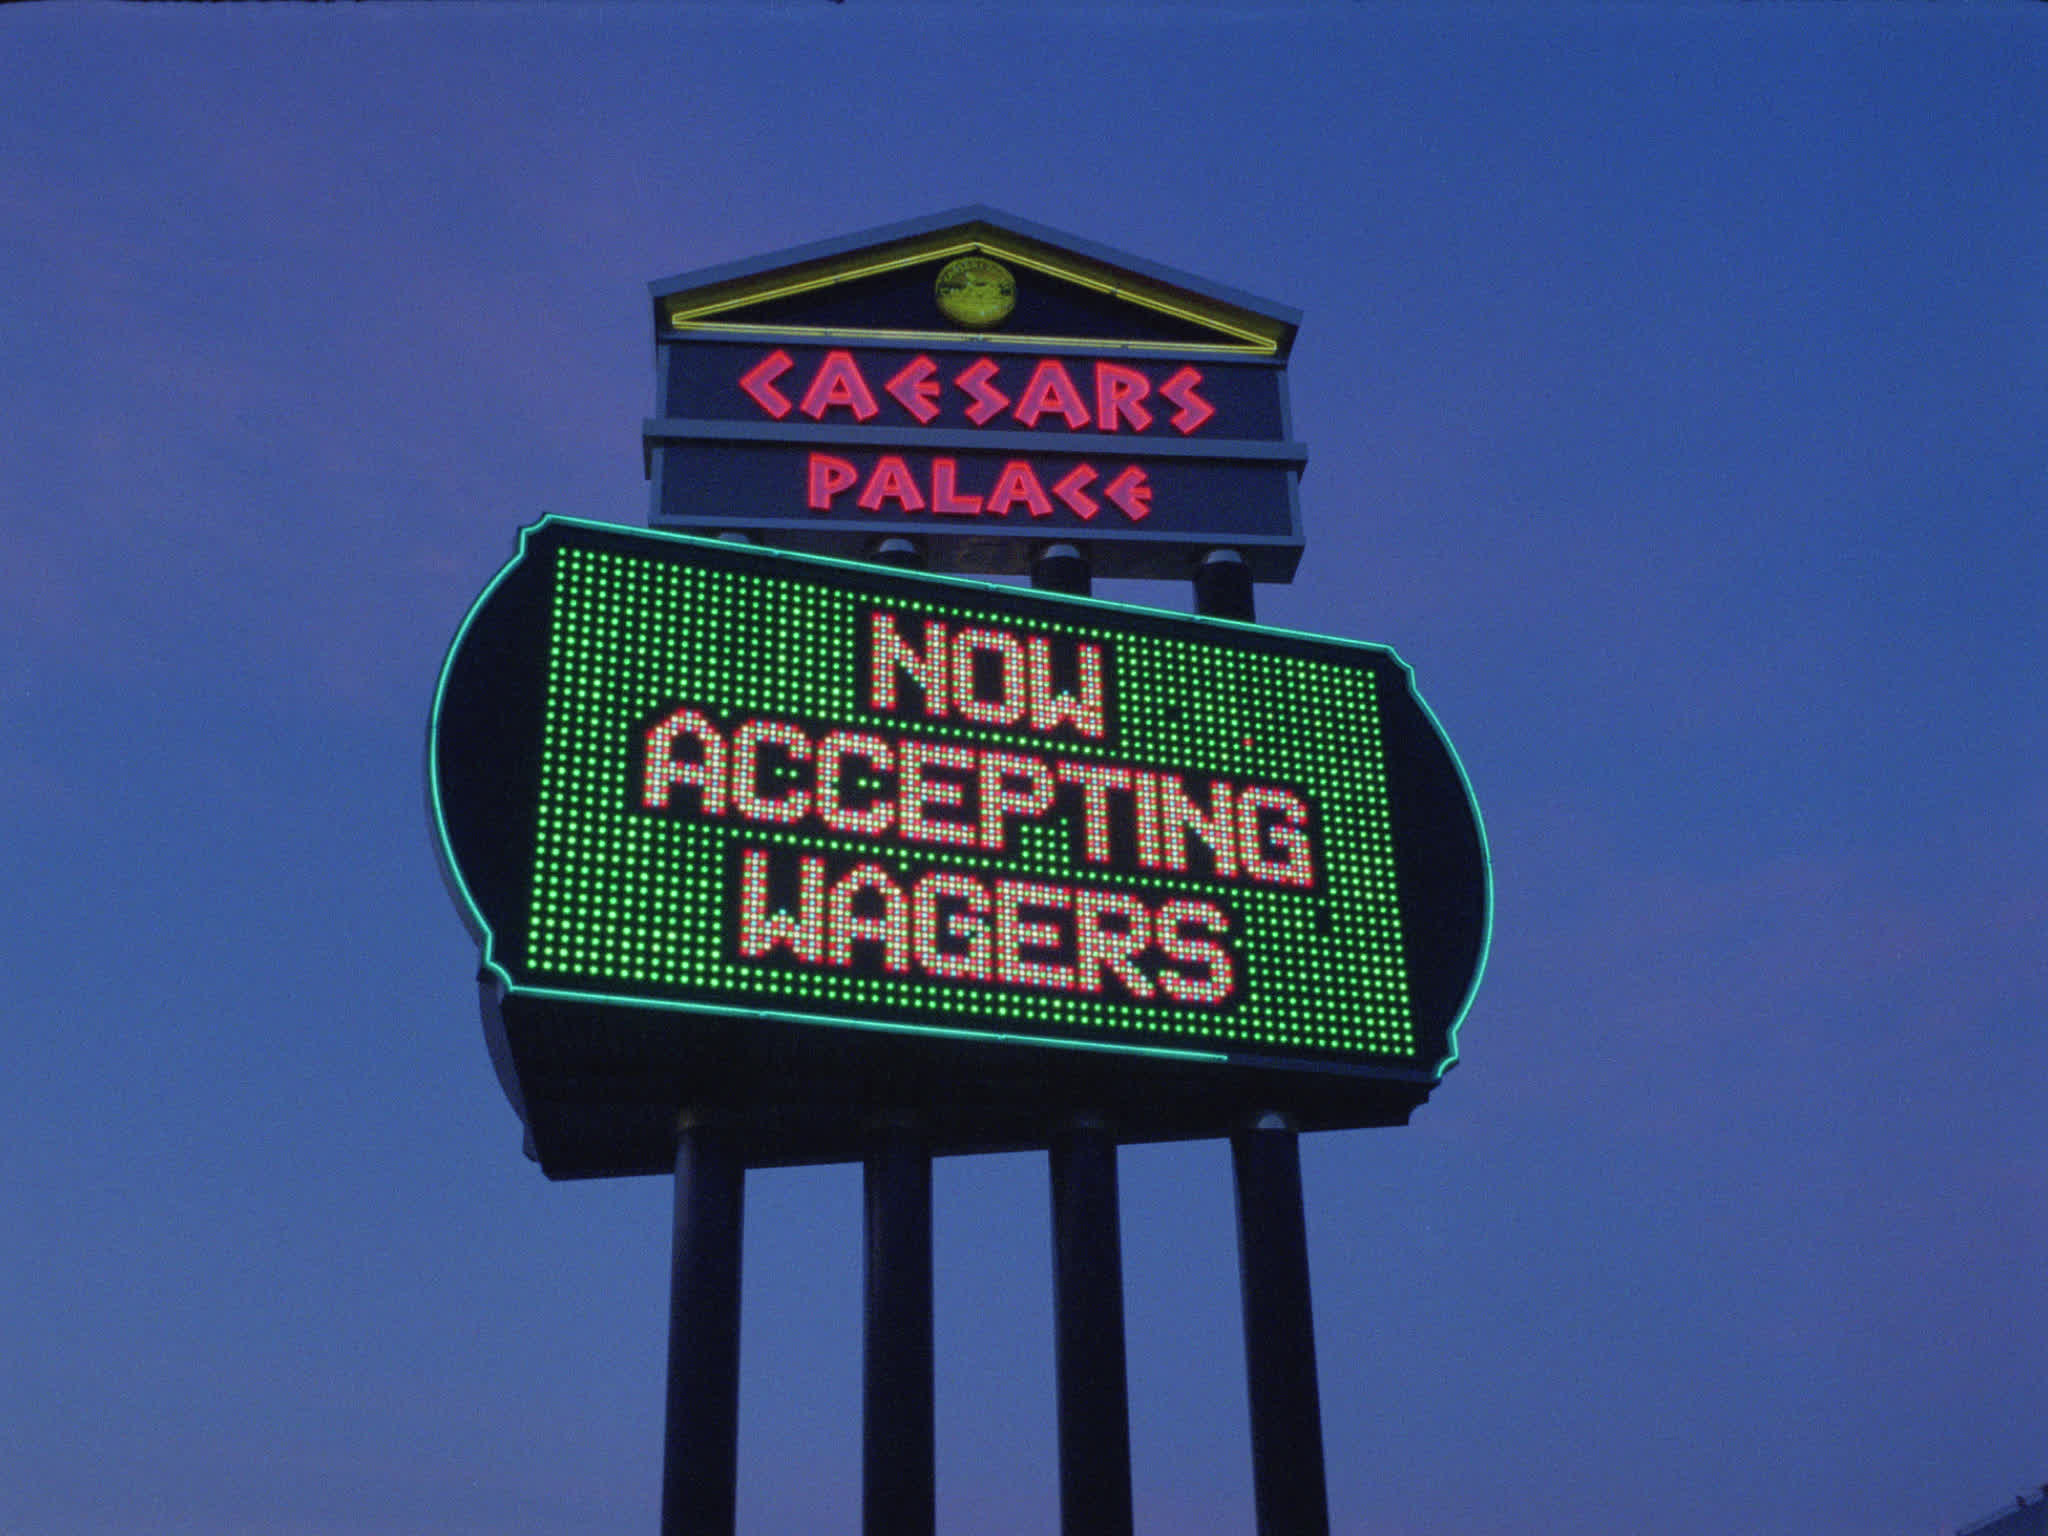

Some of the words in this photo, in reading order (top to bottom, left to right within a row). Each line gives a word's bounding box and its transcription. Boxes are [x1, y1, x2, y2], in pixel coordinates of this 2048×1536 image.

[739, 350, 1215, 434] CAESARS
[808, 453, 1152, 521] PALACE
[870, 611, 1105, 738] NOW
[643, 708, 1314, 887] ACCEPTING
[740, 849, 1235, 1004] WAGERS
